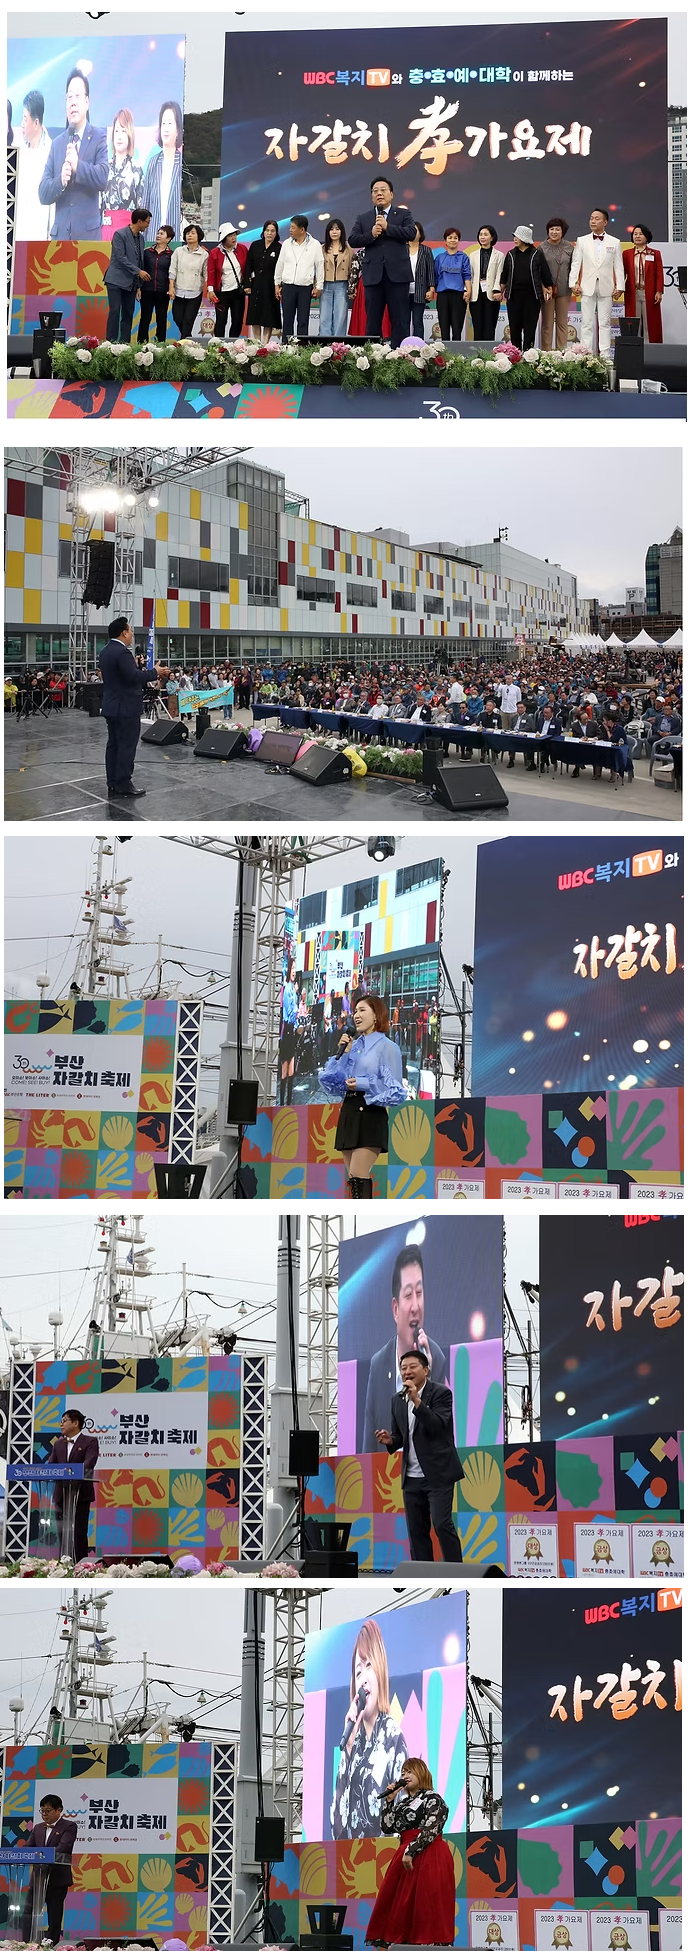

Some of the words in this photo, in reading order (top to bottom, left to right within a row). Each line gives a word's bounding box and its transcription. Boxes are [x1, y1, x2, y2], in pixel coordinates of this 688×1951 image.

[527, 69, 574, 82] 함께하는
[264, 118, 390, 165] 자갈치
[464, 118, 593, 161] 가요제
[573, 922, 677, 980] 자갈치
[54, 1054, 85, 1070] 부산
[52, 1070, 98, 1087] 자갈치
[100, 1070, 131, 1088] 축제
[442, 1183, 455, 1191] 2023
[507, 1186, 522, 1194] 2023
[532, 1187, 550, 1196] 가요제
[564, 1189, 580, 1197] 2023
[592, 1190, 612, 1198] 가요제
[637, 1190, 655, 1198] 2023
[583, 1266, 684, 1332] 자갈
[119, 1414, 149, 1428] 부산
[119, 1429, 164, 1445] 자갈치
[167, 1428, 198, 1445] 축제
[605, 1529, 624, 1537] 가요제
[638, 1530, 654, 1538] 2023
[584, 1588, 682, 1625] WBC복지TV
[89, 1799, 119, 1814] 부산
[88, 1814, 134, 1830] 자갈치
[136, 1813, 167, 1830] 축제
[596, 1916, 612, 1924] 2023
[623, 1917, 643, 1925] 가요제
